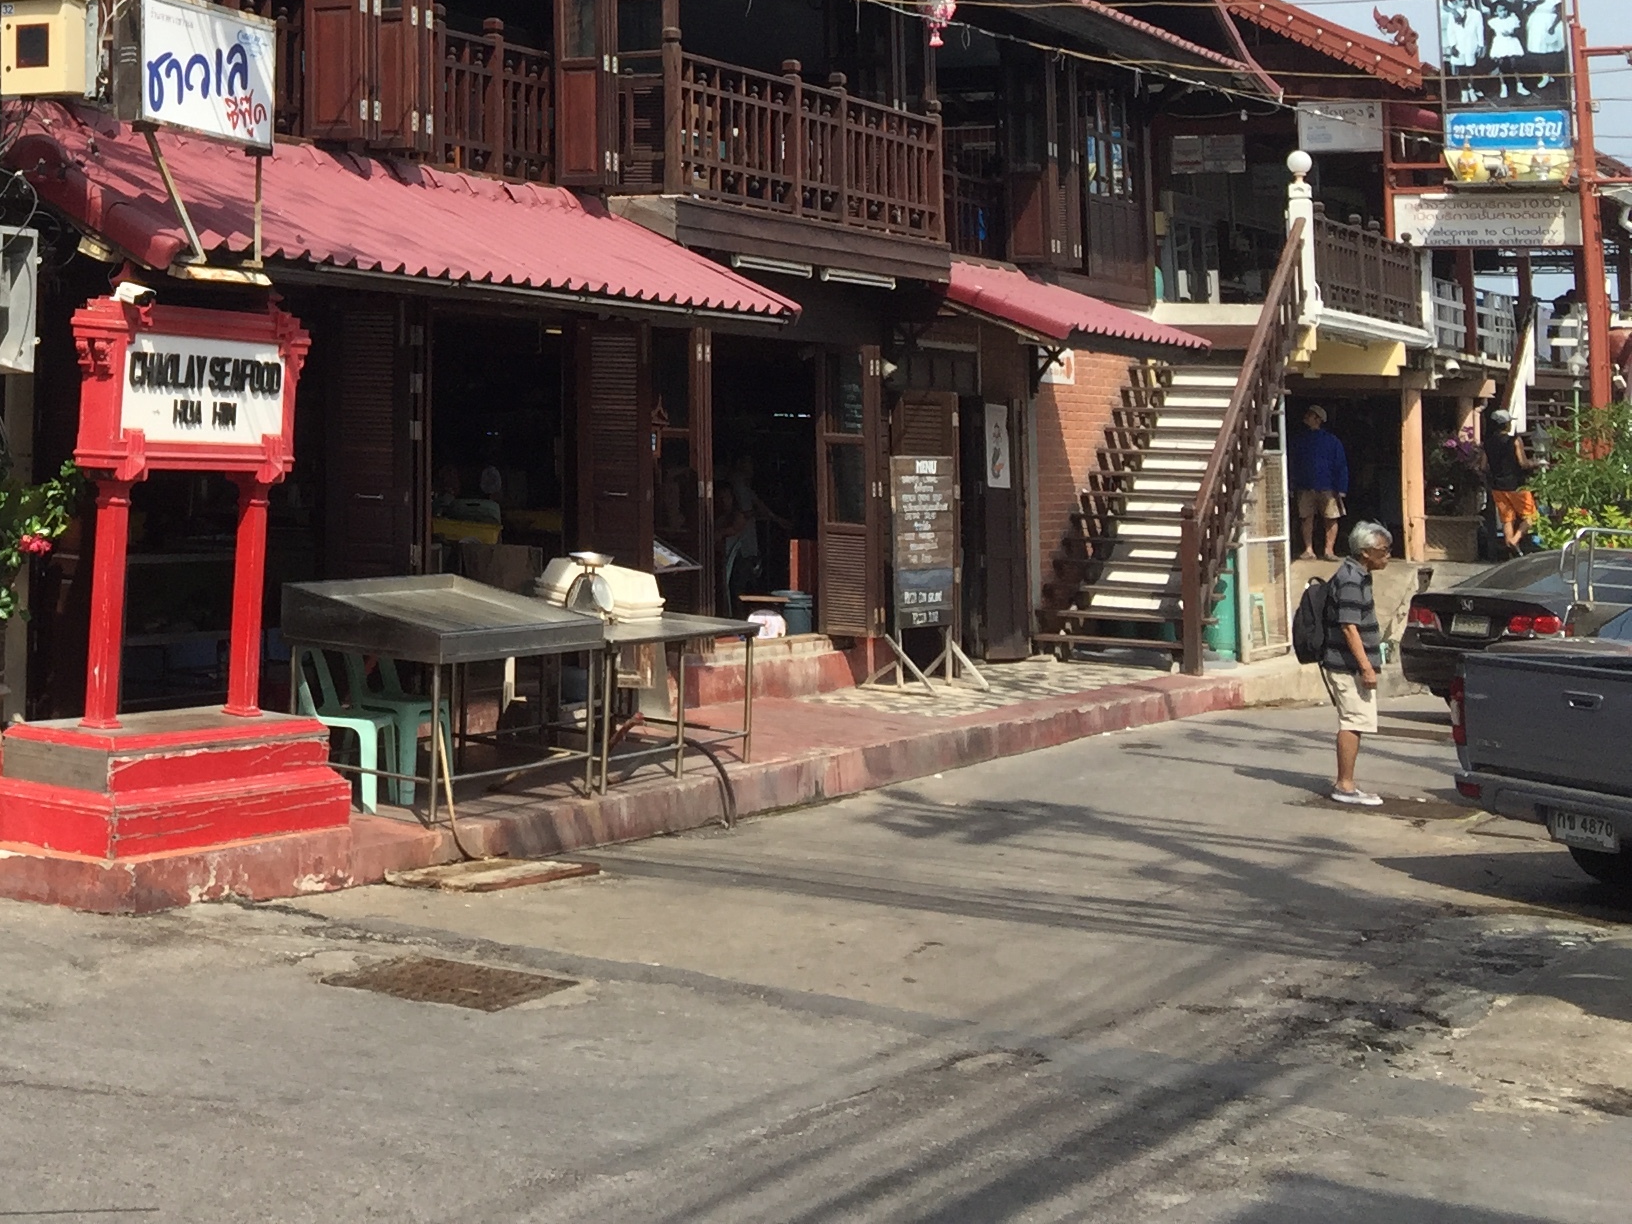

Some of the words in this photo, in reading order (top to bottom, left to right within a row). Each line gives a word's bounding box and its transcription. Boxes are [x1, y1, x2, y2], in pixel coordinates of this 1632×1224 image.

[2, 4, 14, 15] 32
[146, 42, 249, 113] ชาวเล
[1452, 116, 1563, 141] ทรงพระเจริญ
[1417, 227, 1478, 237] Welcome
[1485, 228, 1497, 236] to
[1466, 237, 1494, 245] time
[129, 351, 207, 390] CHAOLAY
[208, 356, 282, 395] SEAFOOD
[172, 399, 203, 426] HUA
[211, 401, 238, 427] HIN
[915, 460, 937, 474] MENU
[1580, 818, 1613, 838] 4870
